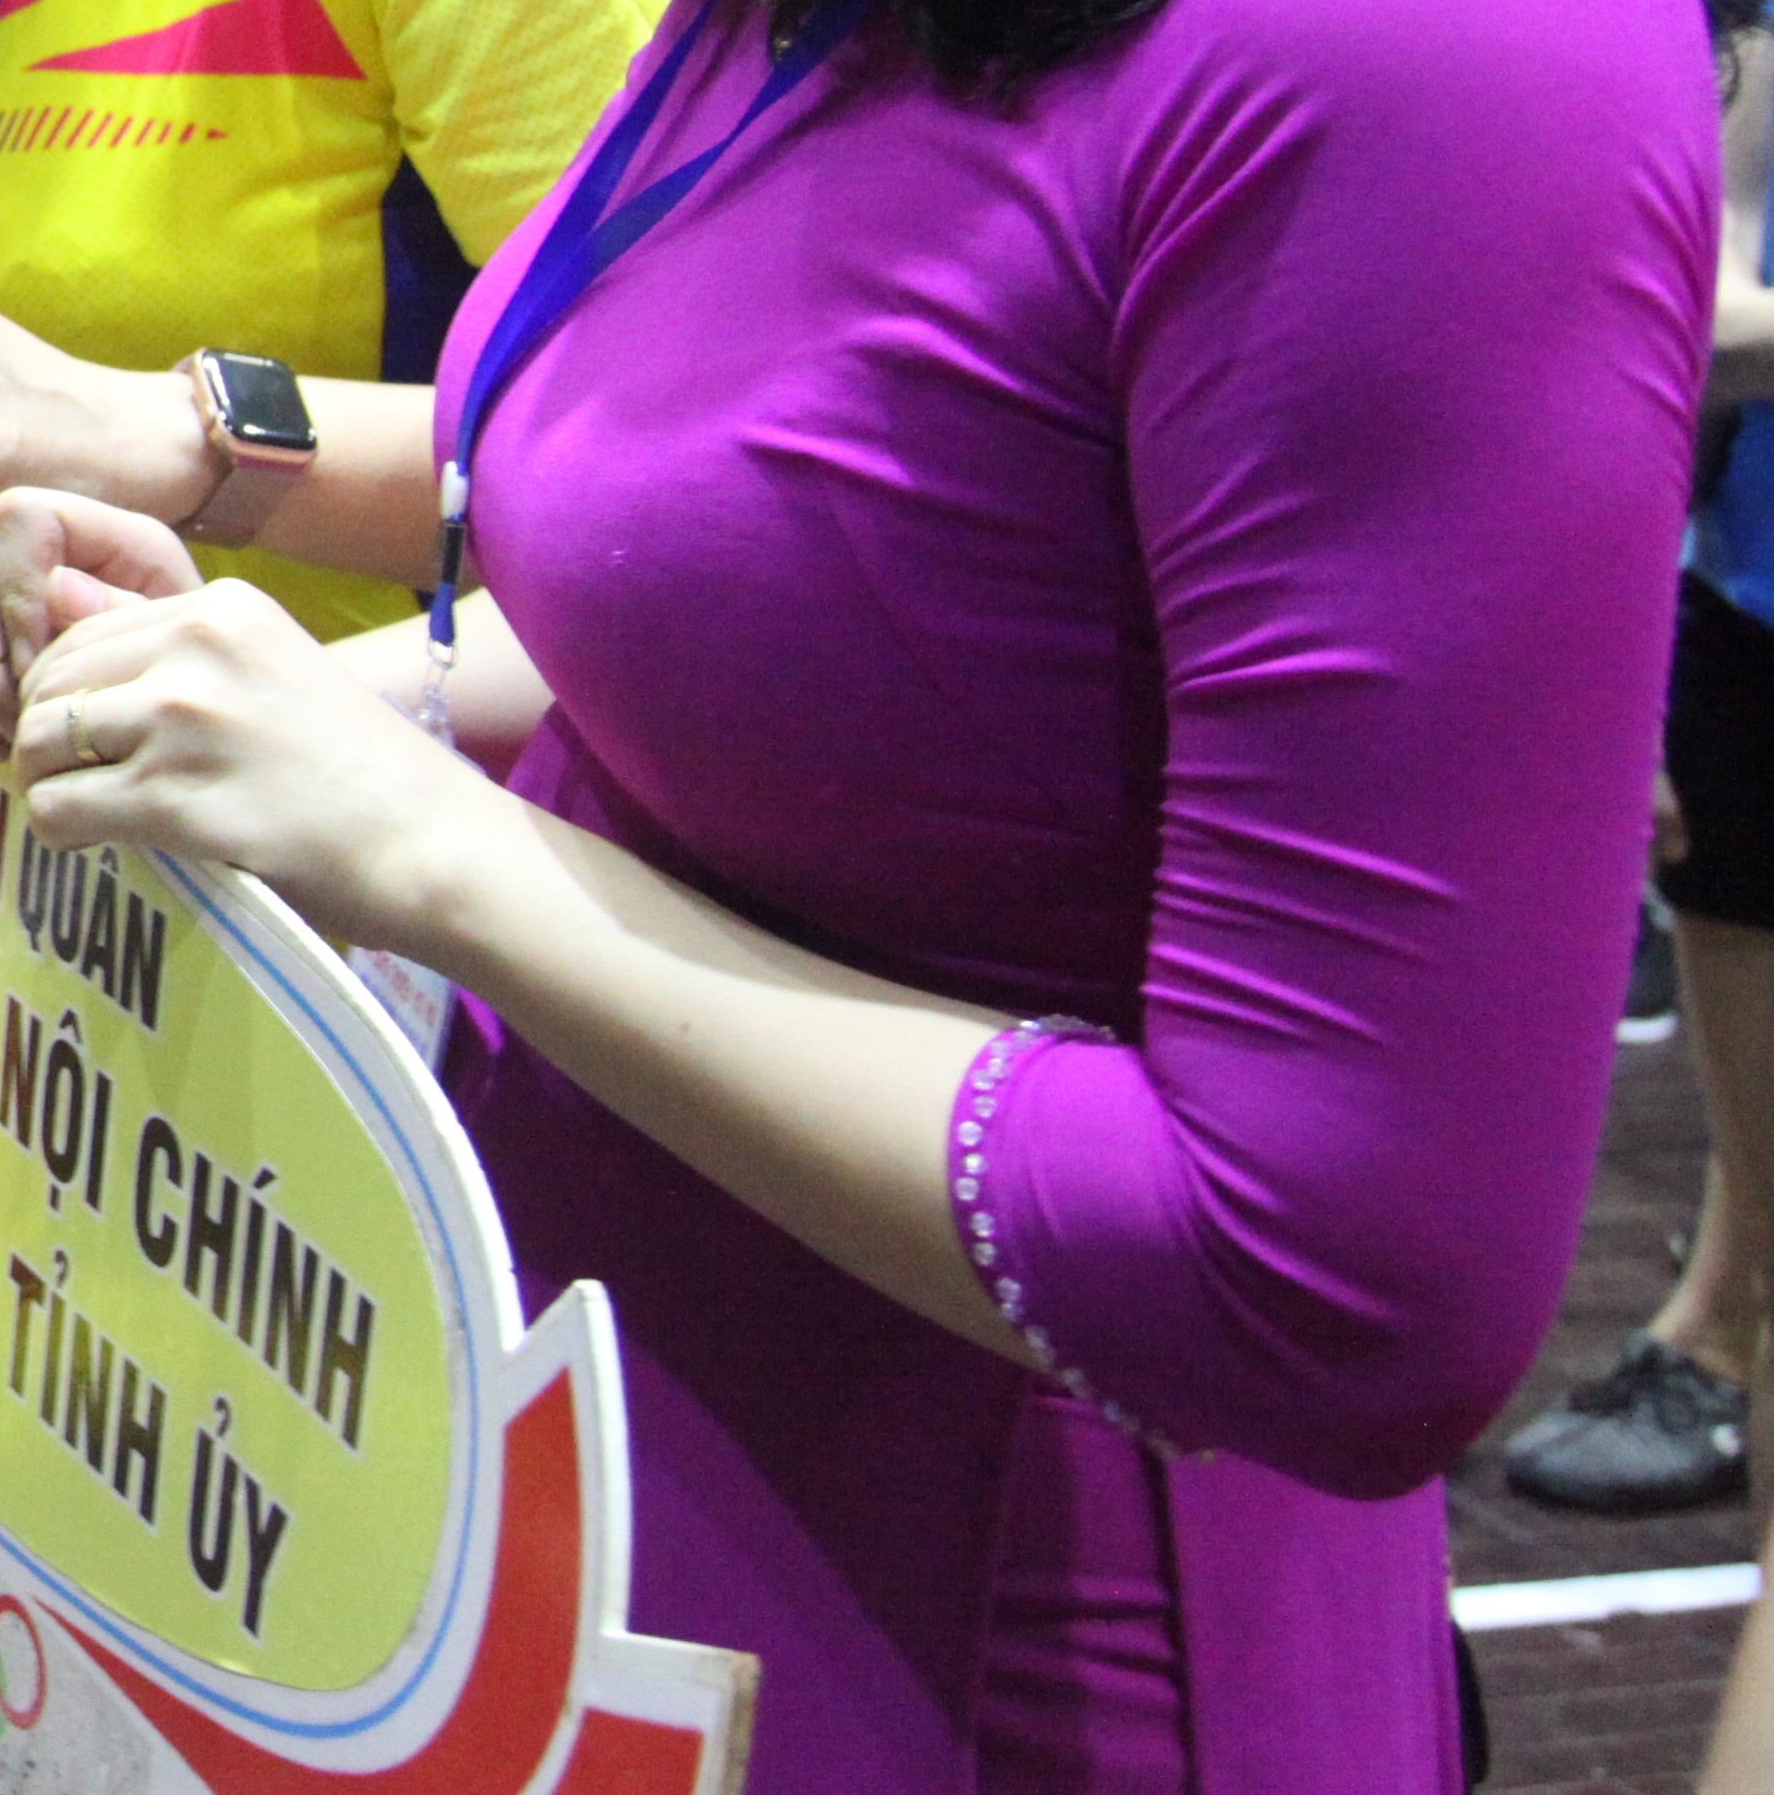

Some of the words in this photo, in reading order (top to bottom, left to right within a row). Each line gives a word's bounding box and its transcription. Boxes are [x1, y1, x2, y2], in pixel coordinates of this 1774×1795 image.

[16, 824, 168, 1033] QUÂN
[8, 1247, 167, 1531] TỈNH
[187, 1395, 290, 1640] ỦY
[134, 1115, 378, 1454] CHÍNH
